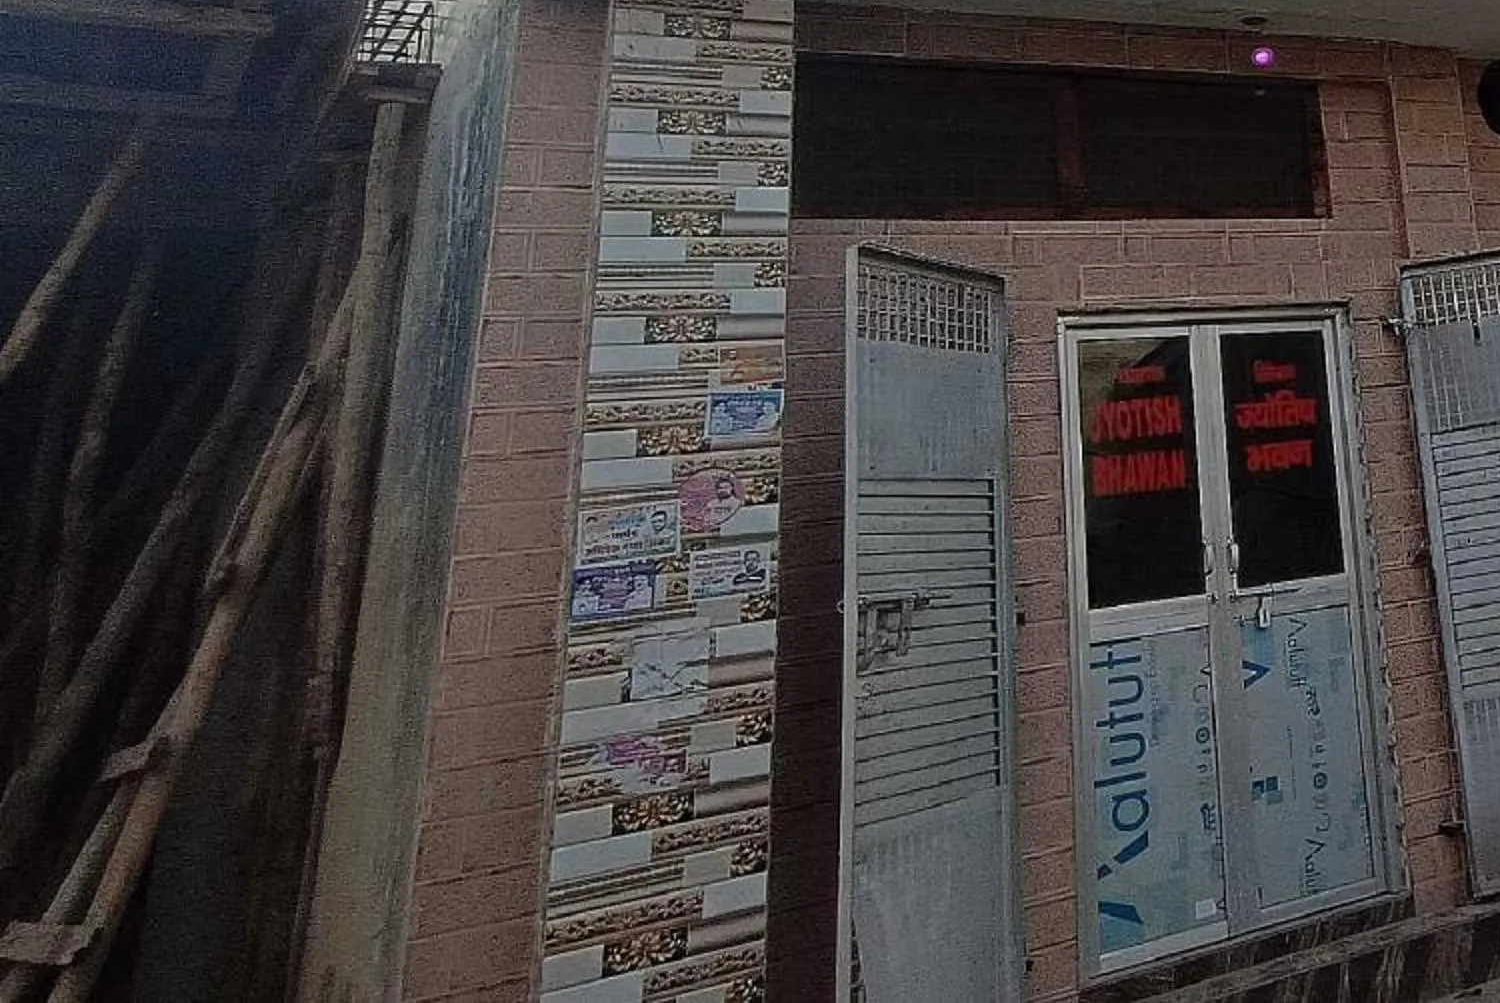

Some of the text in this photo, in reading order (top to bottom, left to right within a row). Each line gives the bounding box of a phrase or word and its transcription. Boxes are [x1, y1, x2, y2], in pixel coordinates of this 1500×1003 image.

[1090, 395, 1182, 443] JYOTISH
[1092, 449, 1185, 497] BHAWAN
[1245, 439, 1313, 472] भवन
